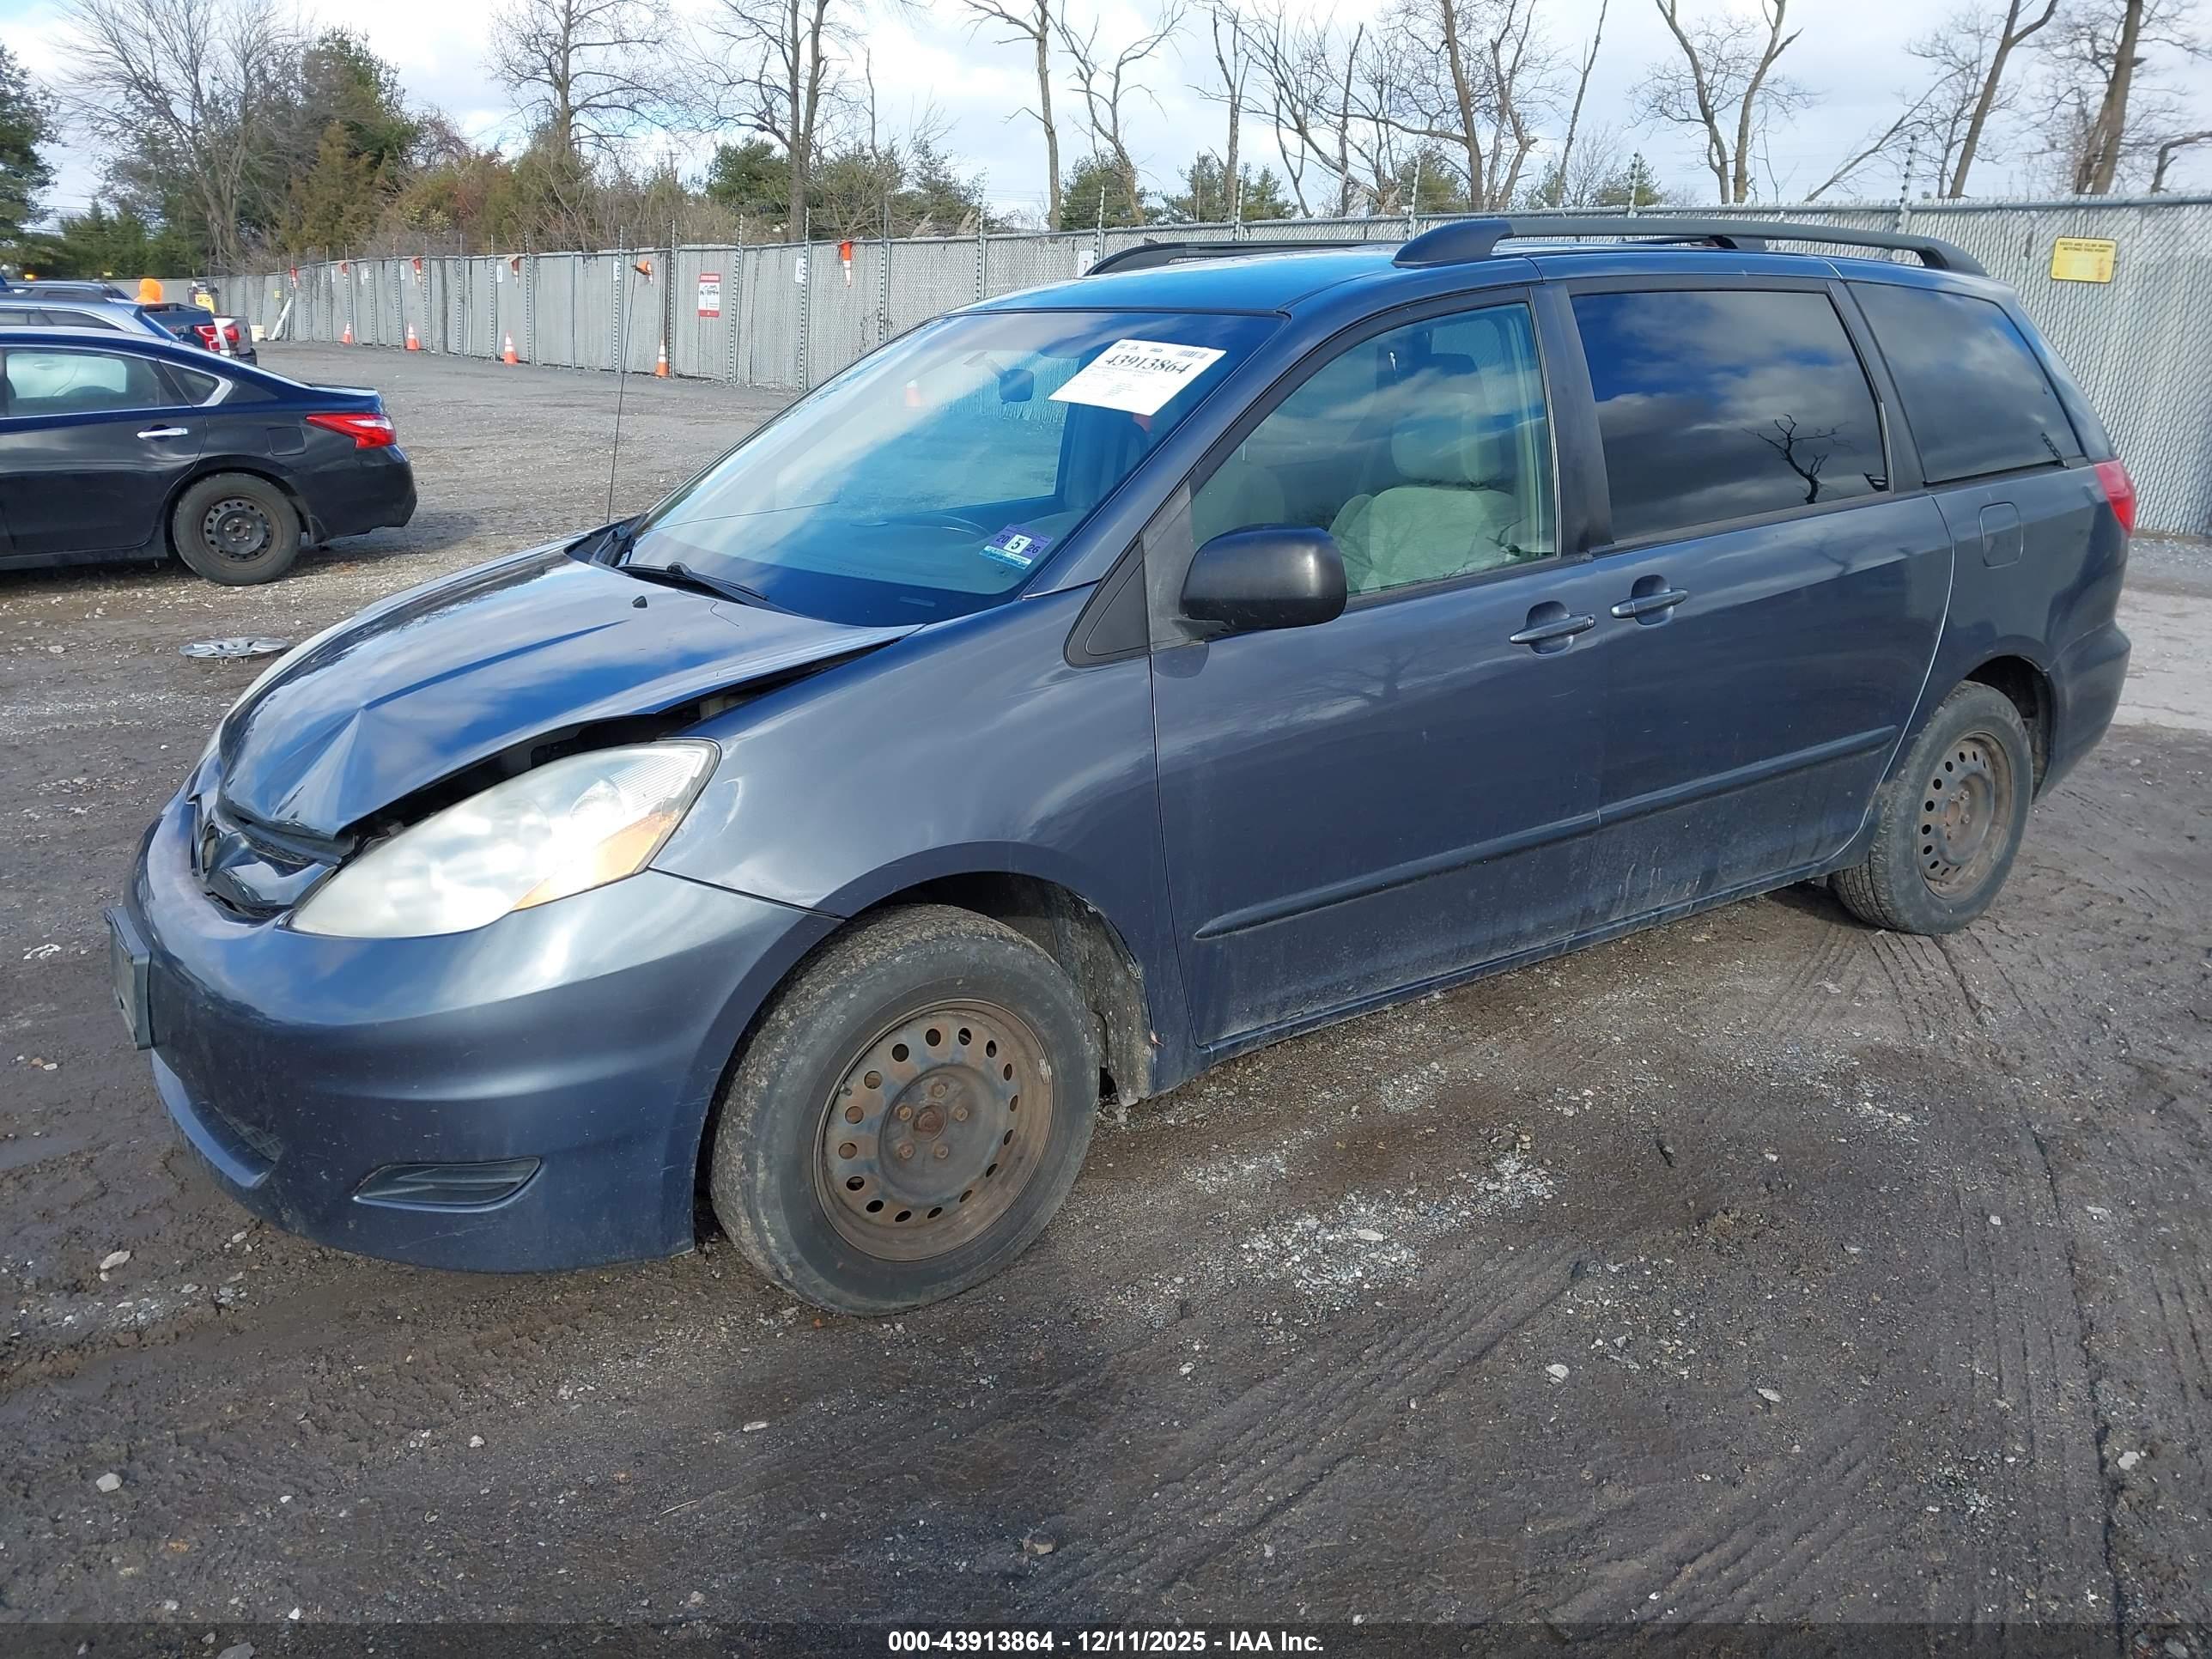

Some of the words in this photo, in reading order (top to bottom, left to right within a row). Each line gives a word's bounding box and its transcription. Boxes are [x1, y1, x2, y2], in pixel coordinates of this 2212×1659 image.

[1105, 354, 1194, 374] 43913864
[995, 534, 1011, 544] 20
[1011, 538, 1024, 550] 5
[1025, 544, 1041, 554] 26
